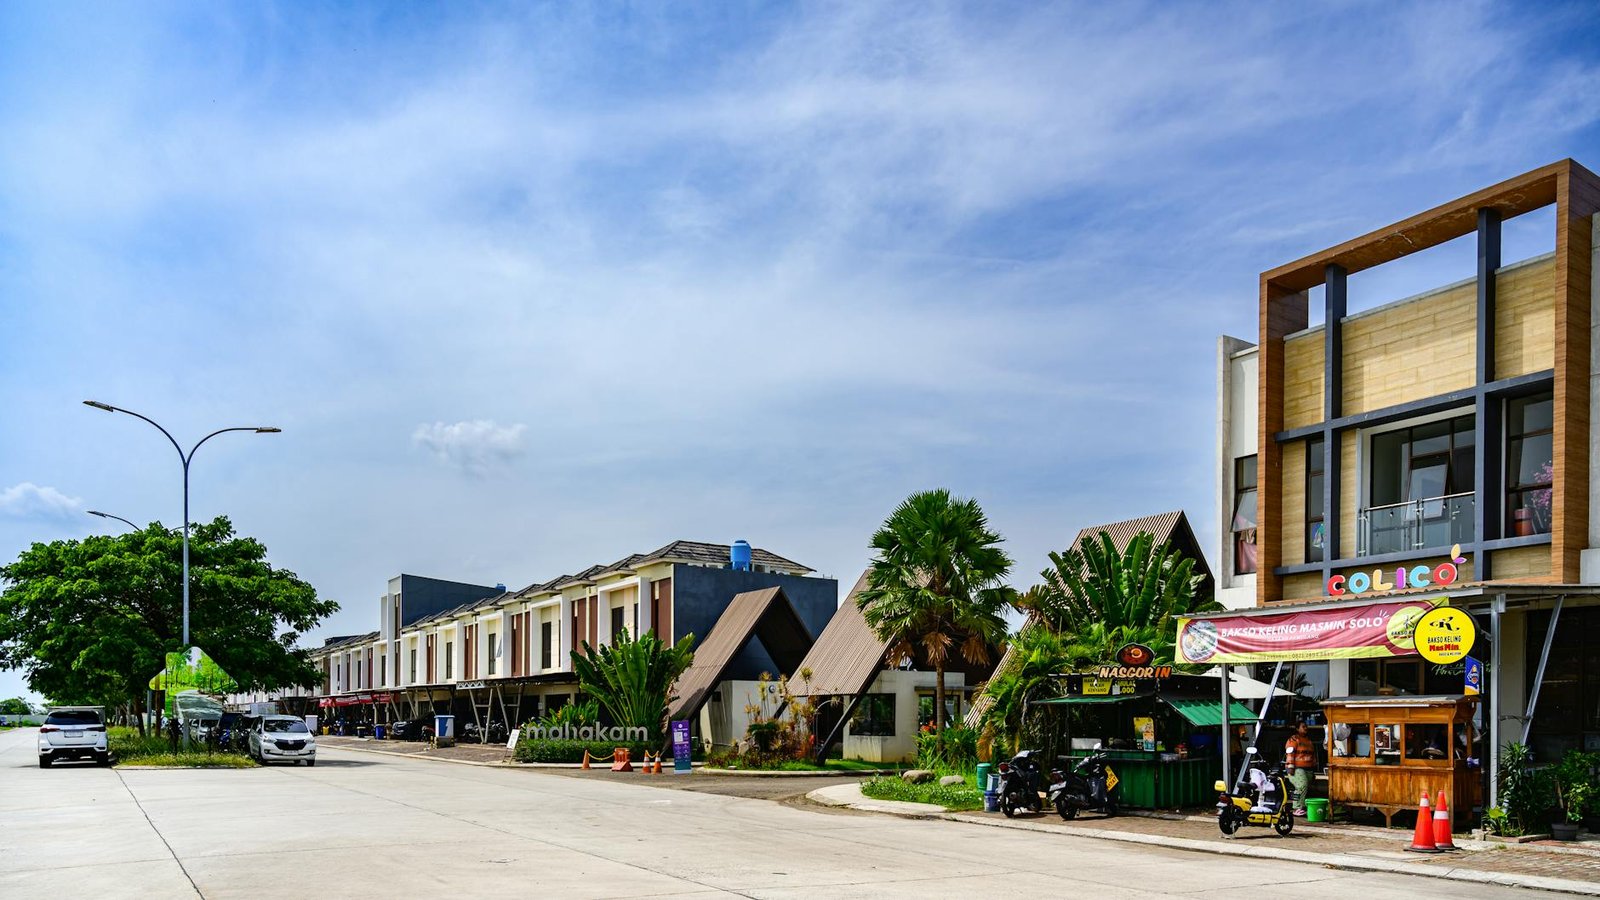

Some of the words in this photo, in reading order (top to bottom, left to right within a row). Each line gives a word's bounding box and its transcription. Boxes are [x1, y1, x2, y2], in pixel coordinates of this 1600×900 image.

[1327, 562, 1457, 596] COLICO
[1221, 627, 1256, 637] BAKSO
[1258, 624, 1297, 636] KELING
[1299, 620, 1345, 632] MASMIN
[1348, 617, 1383, 629] SOLO
[1427, 636, 1443, 644] BAKSO
[1444, 635, 1462, 643] KELING
[526, 721, 648, 742] mahakam
